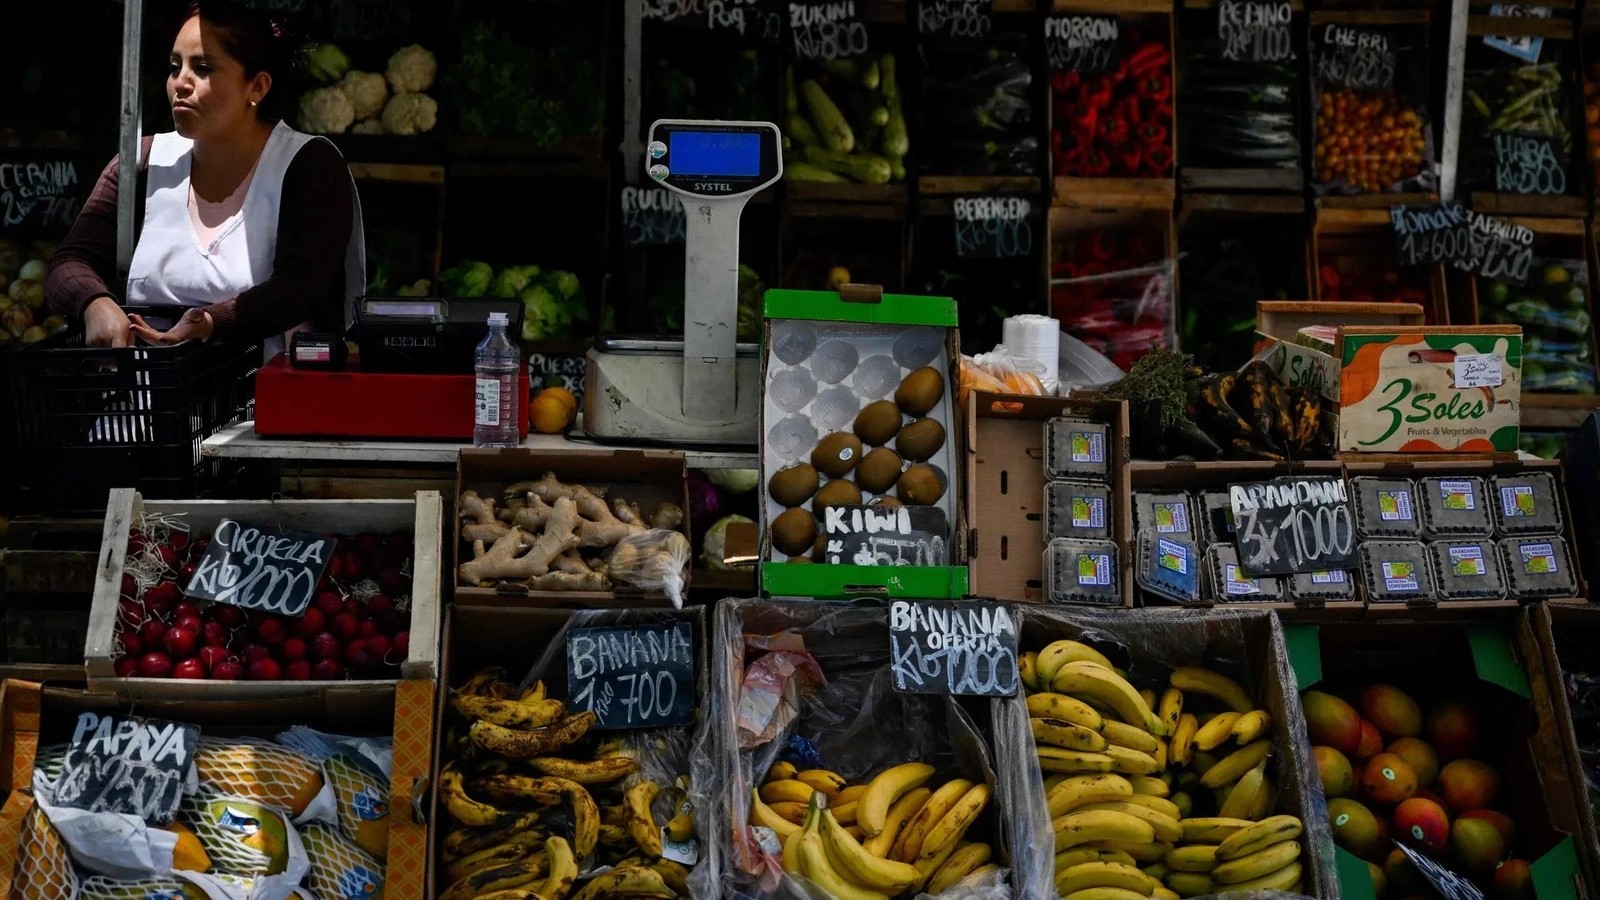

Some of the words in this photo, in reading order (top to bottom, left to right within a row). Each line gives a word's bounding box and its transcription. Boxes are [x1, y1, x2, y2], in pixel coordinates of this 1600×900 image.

[788, 0, 856, 28] ZUKINI
[1044, 16, 1119, 41] MORRON
[1218, 0, 1292, 28] PEPINO
[1324, 24, 1388, 54] CHERRI
[1495, 135, 1556, 164] HABA
[693, 182, 732, 192] SYSTEL
[1358, 378, 1412, 446] 3
[1405, 392, 1486, 423] Soles
[1407, 427, 1430, 436] Fruits
[1433, 428, 1440, 436] &
[1441, 426, 1487, 437] Vegetables
[825, 506, 911, 535] KIWI
[1280, 504, 1353, 566] 1000
[215, 520, 326, 567] CIRUELA
[215, 556, 315, 616] 2000
[891, 600, 1016, 637] BANANA
[572, 626, 690, 680] BANANA
[927, 631, 1003, 653] OFERTA
[574, 677, 596, 712] 1
[616, 670, 678, 724] 700
[72, 712, 187, 767] PAPAYA
